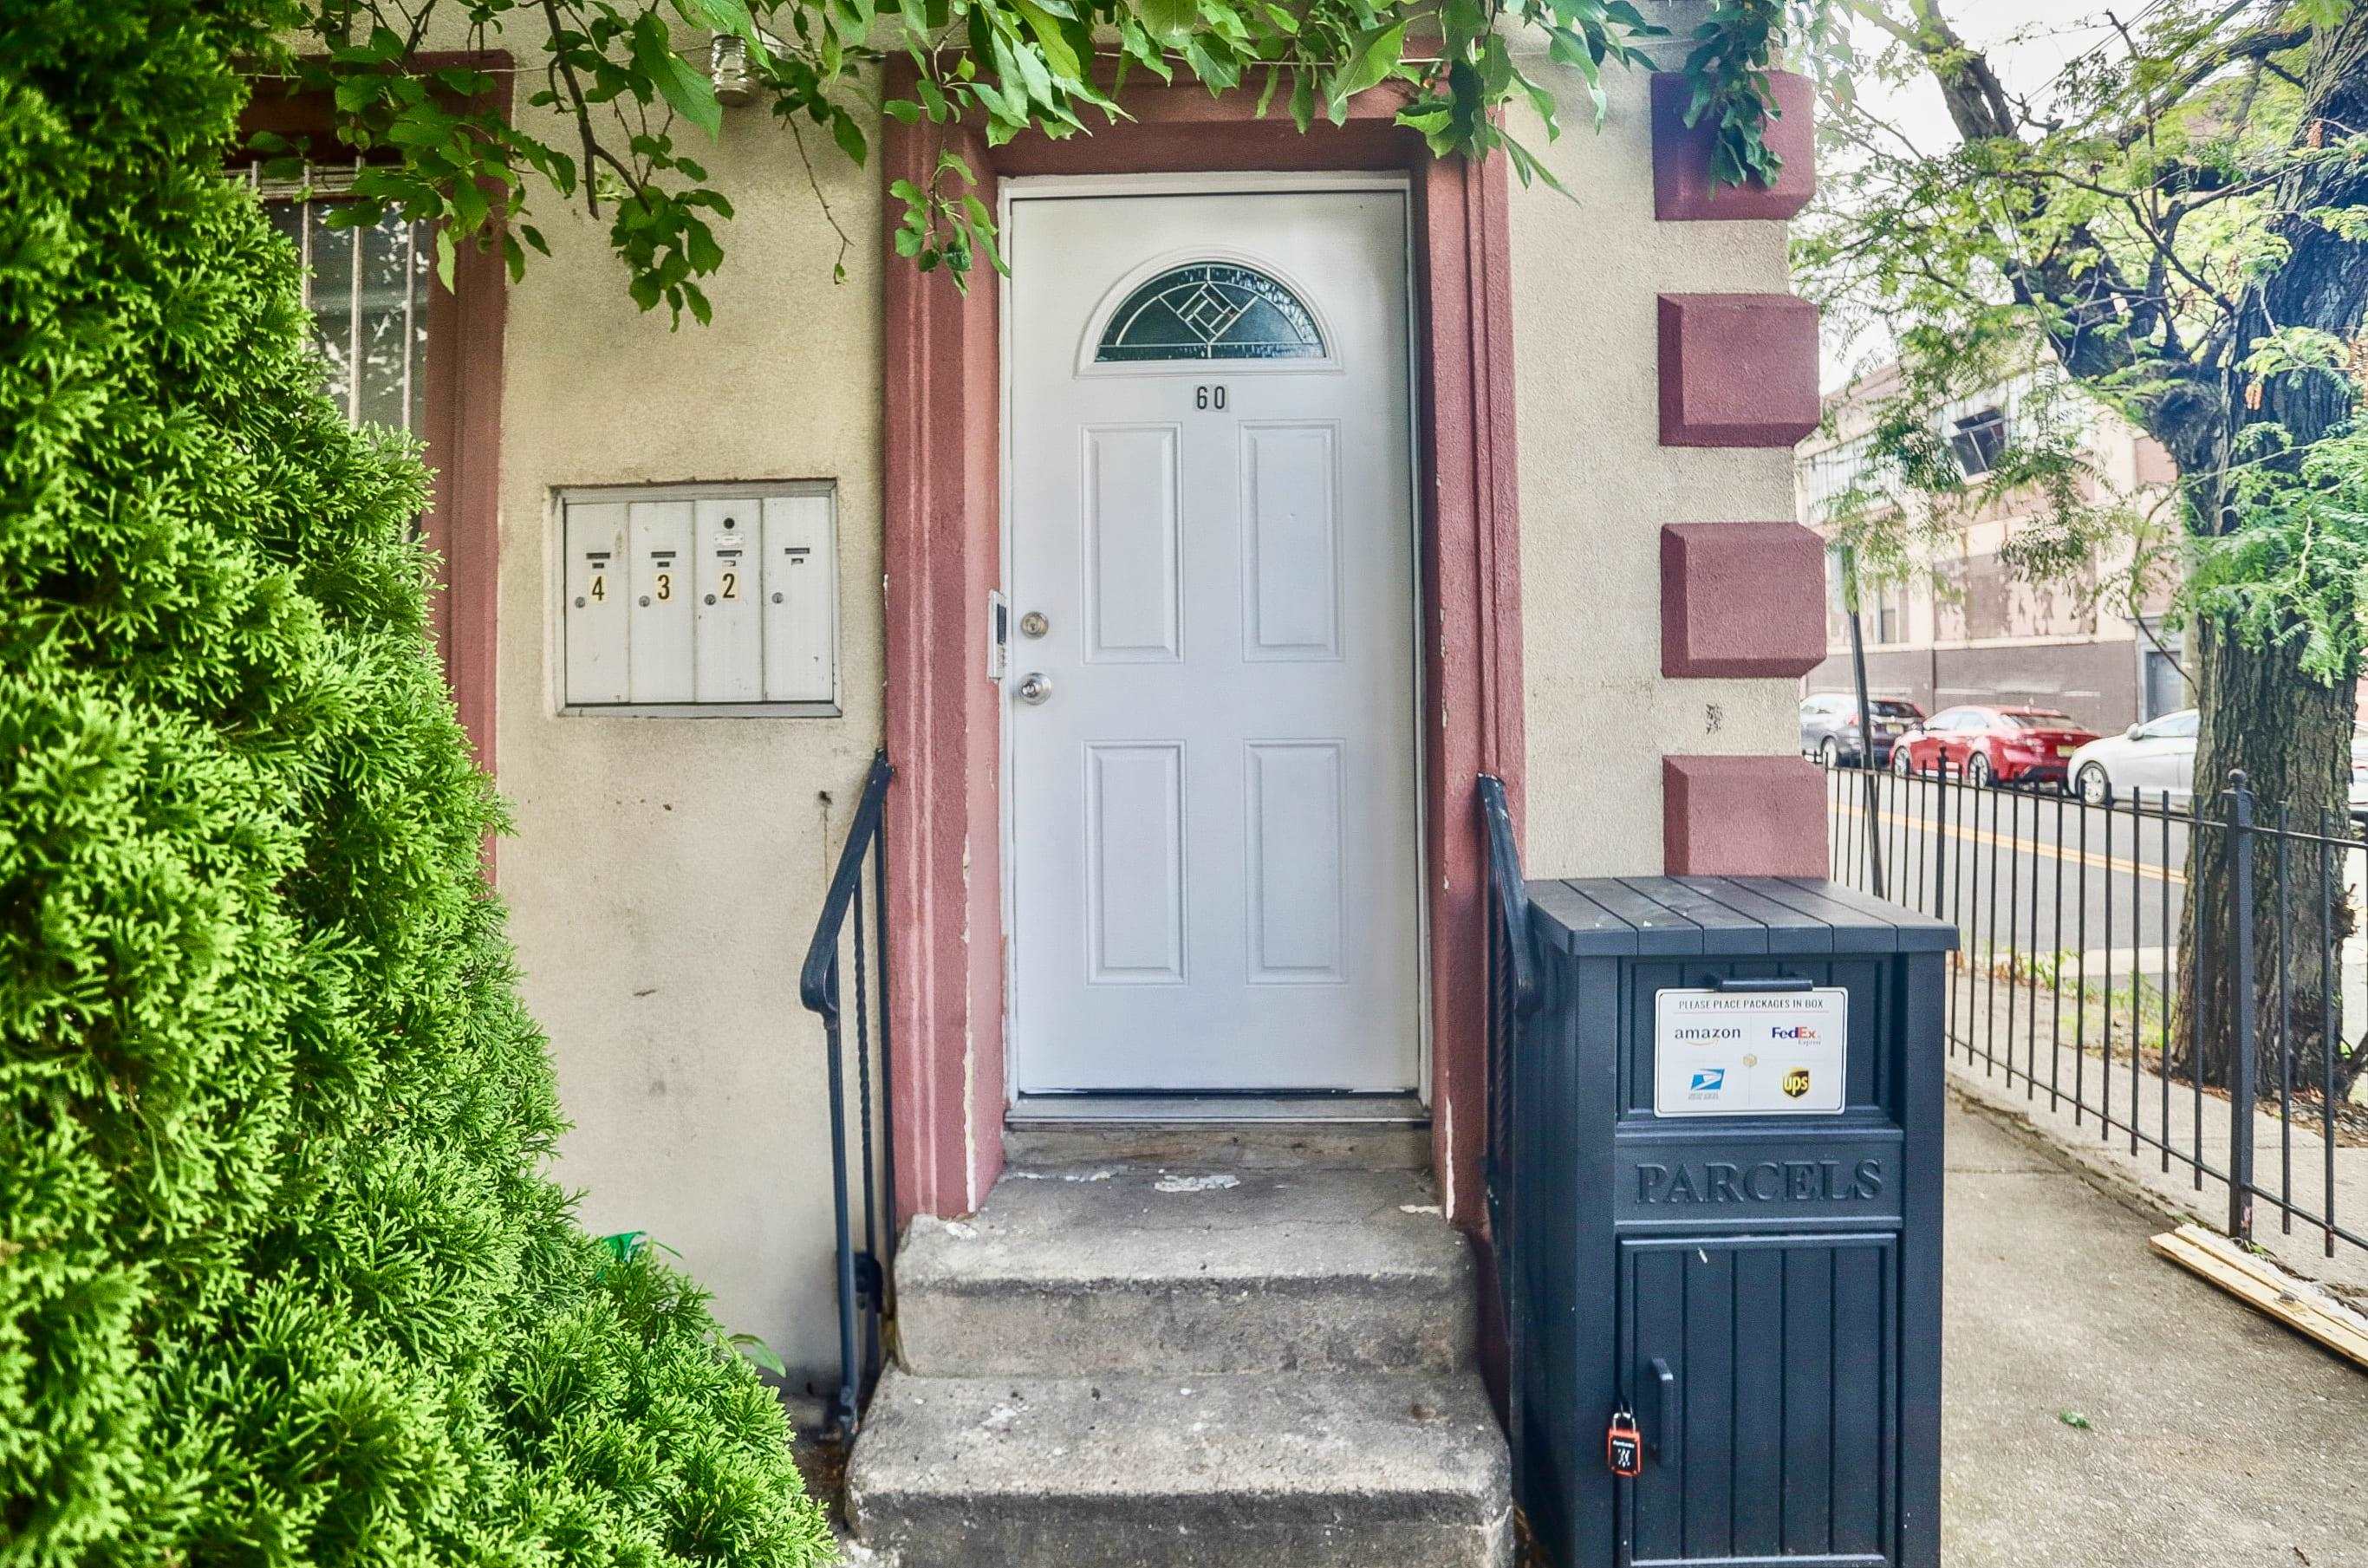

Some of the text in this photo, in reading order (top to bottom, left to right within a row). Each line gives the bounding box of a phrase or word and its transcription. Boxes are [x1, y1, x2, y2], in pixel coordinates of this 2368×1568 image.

[1196, 386, 1226, 410] 60
[591, 576, 605, 602] 4
[657, 574, 671, 601] 3
[722, 573, 736, 599] 2
[1679, 999, 1824, 1010] PLEASE PLACE PACKAGES IN BOX
[1675, 1027, 1741, 1039] amazon
[1772, 1026, 1818, 1039] FedEx
[1784, 1076, 1809, 1096] ups
[1635, 1160, 1883, 1203] PARCELS
